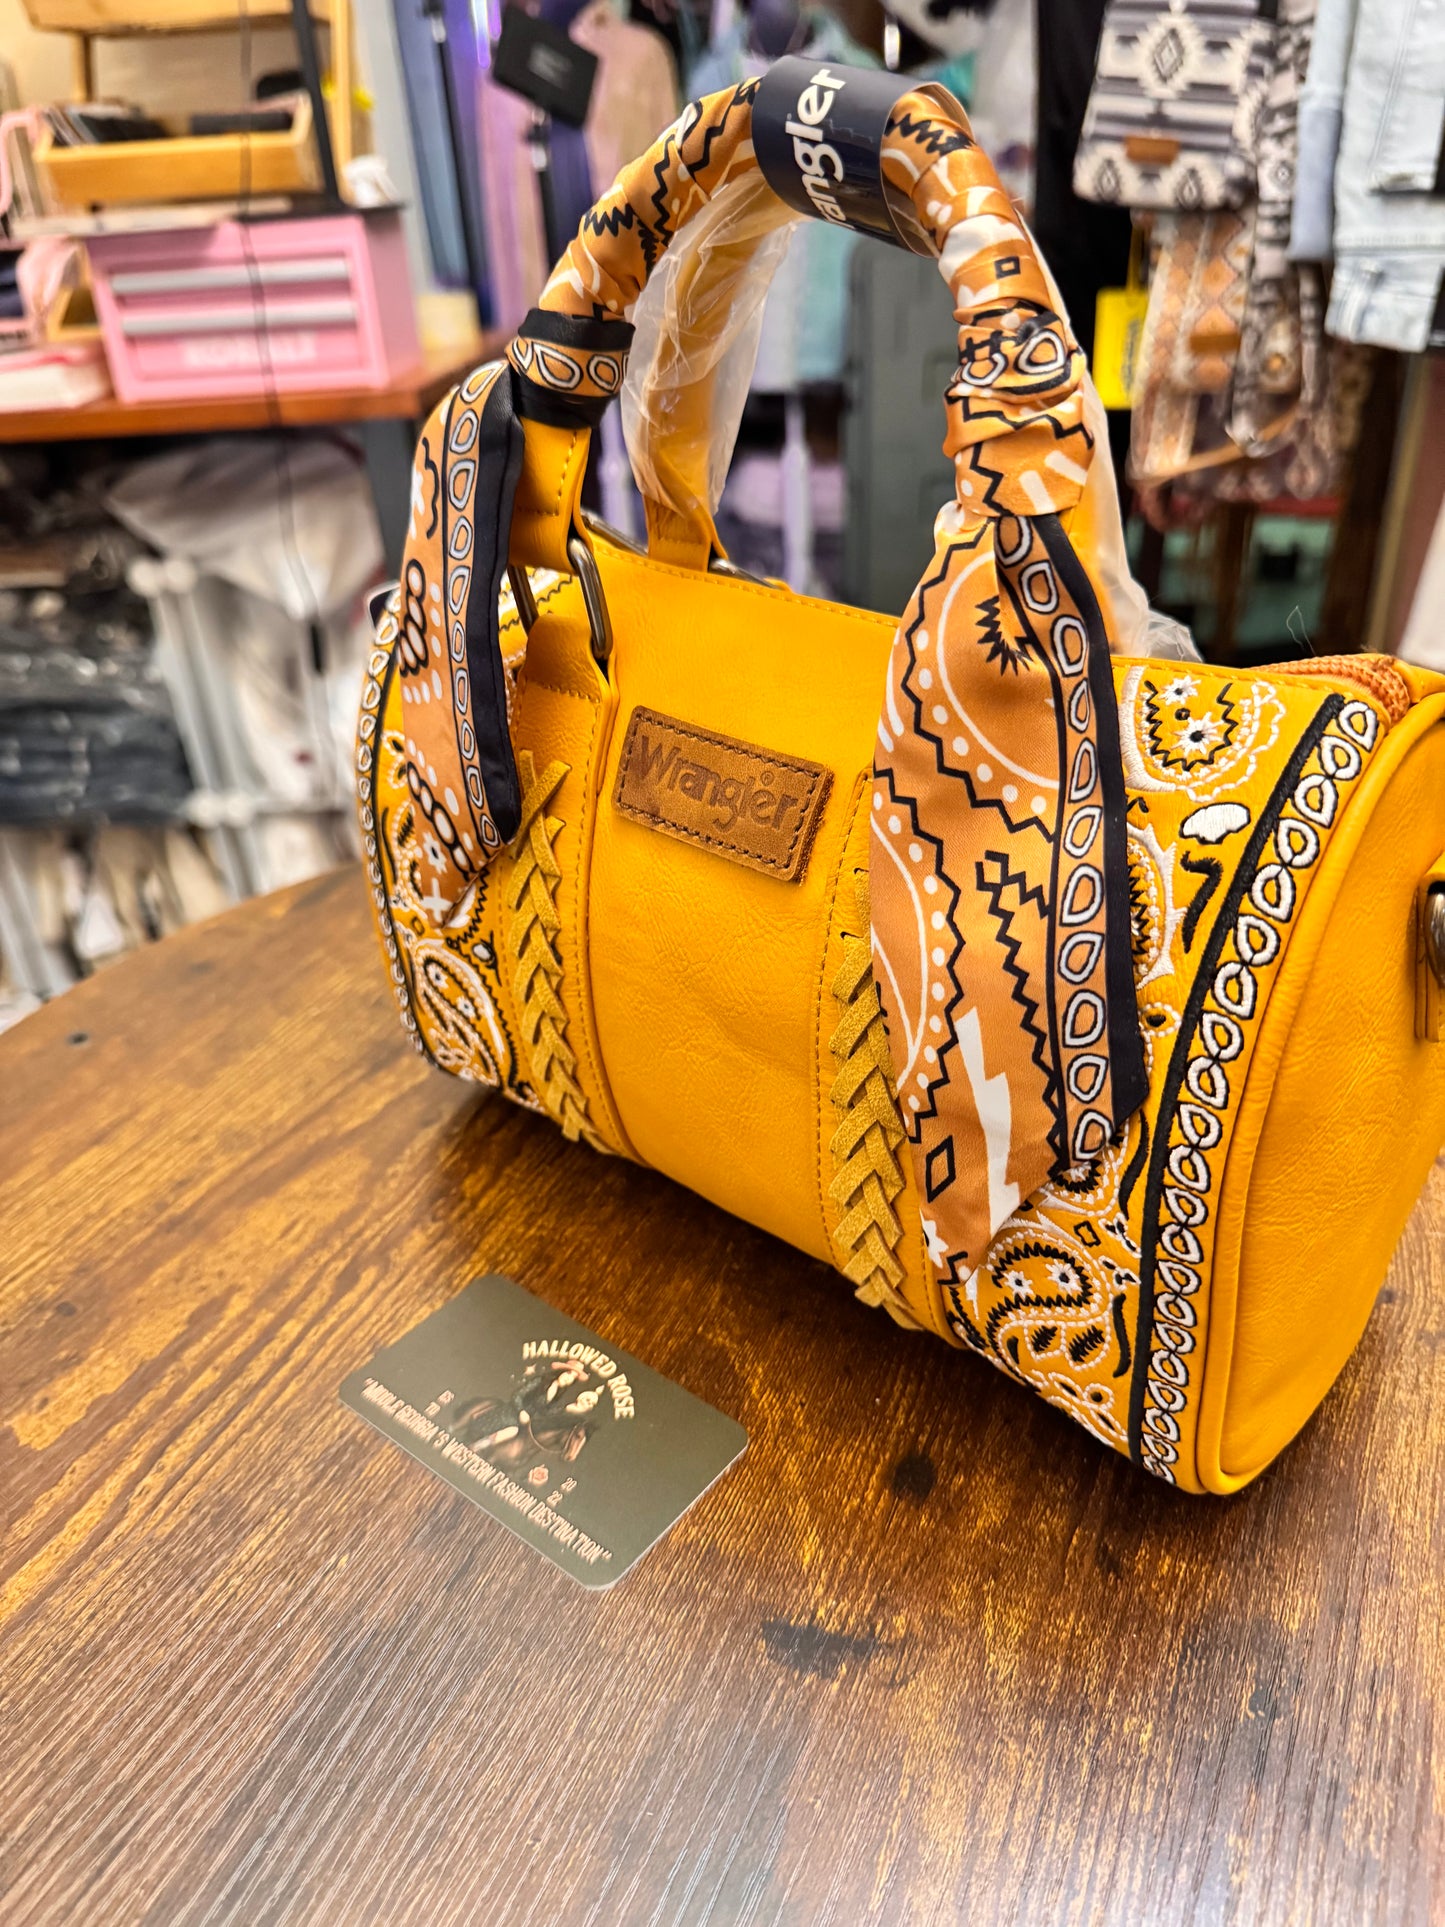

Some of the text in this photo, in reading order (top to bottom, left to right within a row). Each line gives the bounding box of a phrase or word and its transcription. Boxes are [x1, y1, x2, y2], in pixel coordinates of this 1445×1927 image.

[785, 68, 856, 230] rangler
[641, 735, 799, 834] Wrangler
[522, 1339, 635, 1420] HALLOWED ROSE
[441, 1437, 497, 1486] WESTERN
[485, 1470, 538, 1518] FASHION
[561, 1477, 577, 1492] 20
